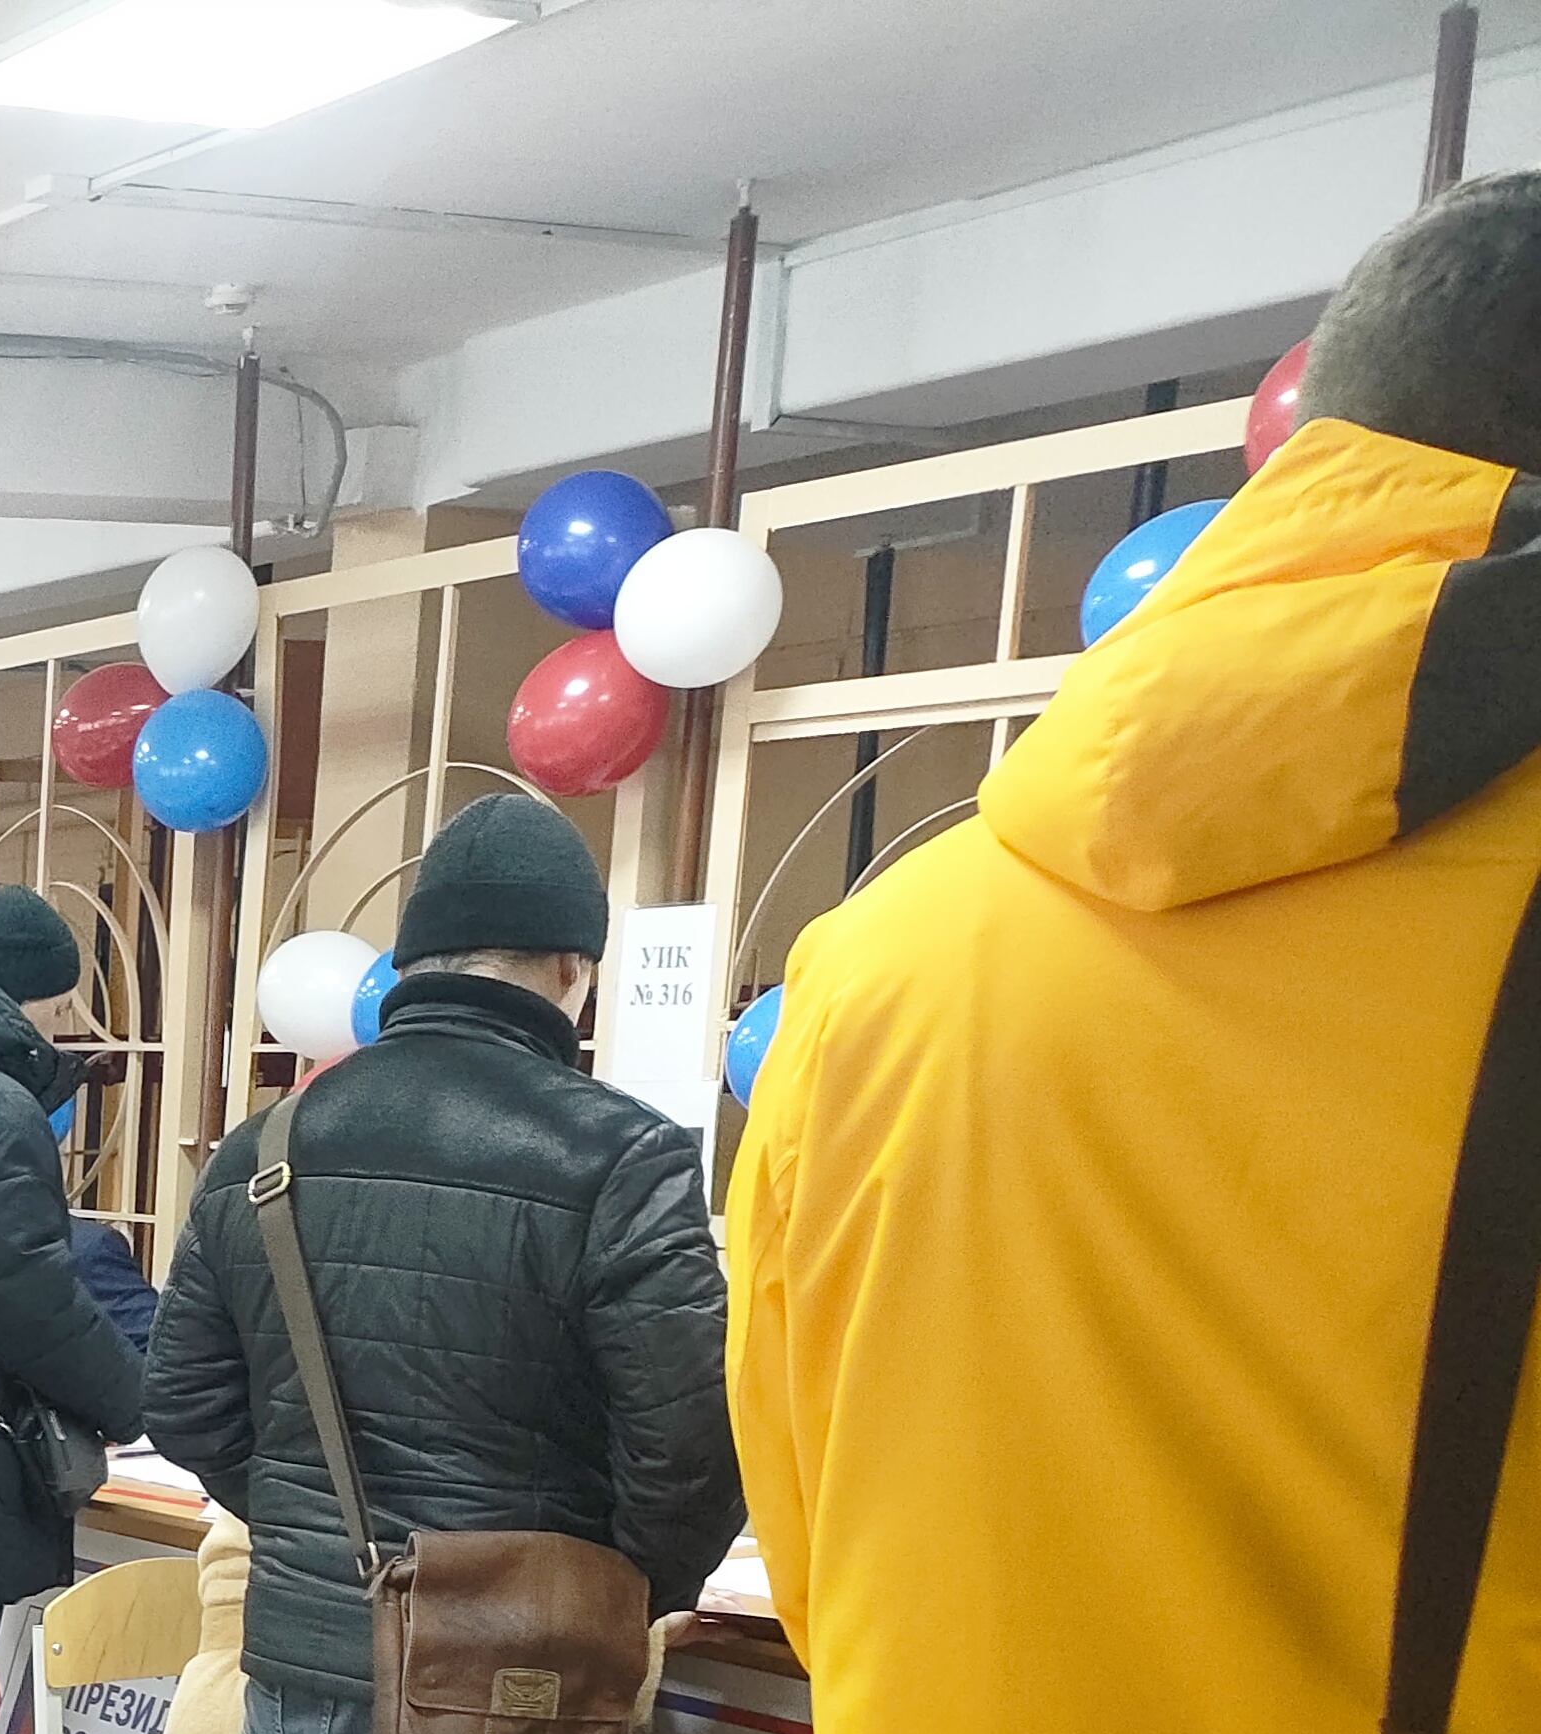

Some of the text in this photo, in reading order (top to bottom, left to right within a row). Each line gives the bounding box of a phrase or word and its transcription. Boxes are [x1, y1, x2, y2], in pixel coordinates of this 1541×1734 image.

[640, 946, 692, 969] УИК
[630, 981, 693, 1006] № 316
